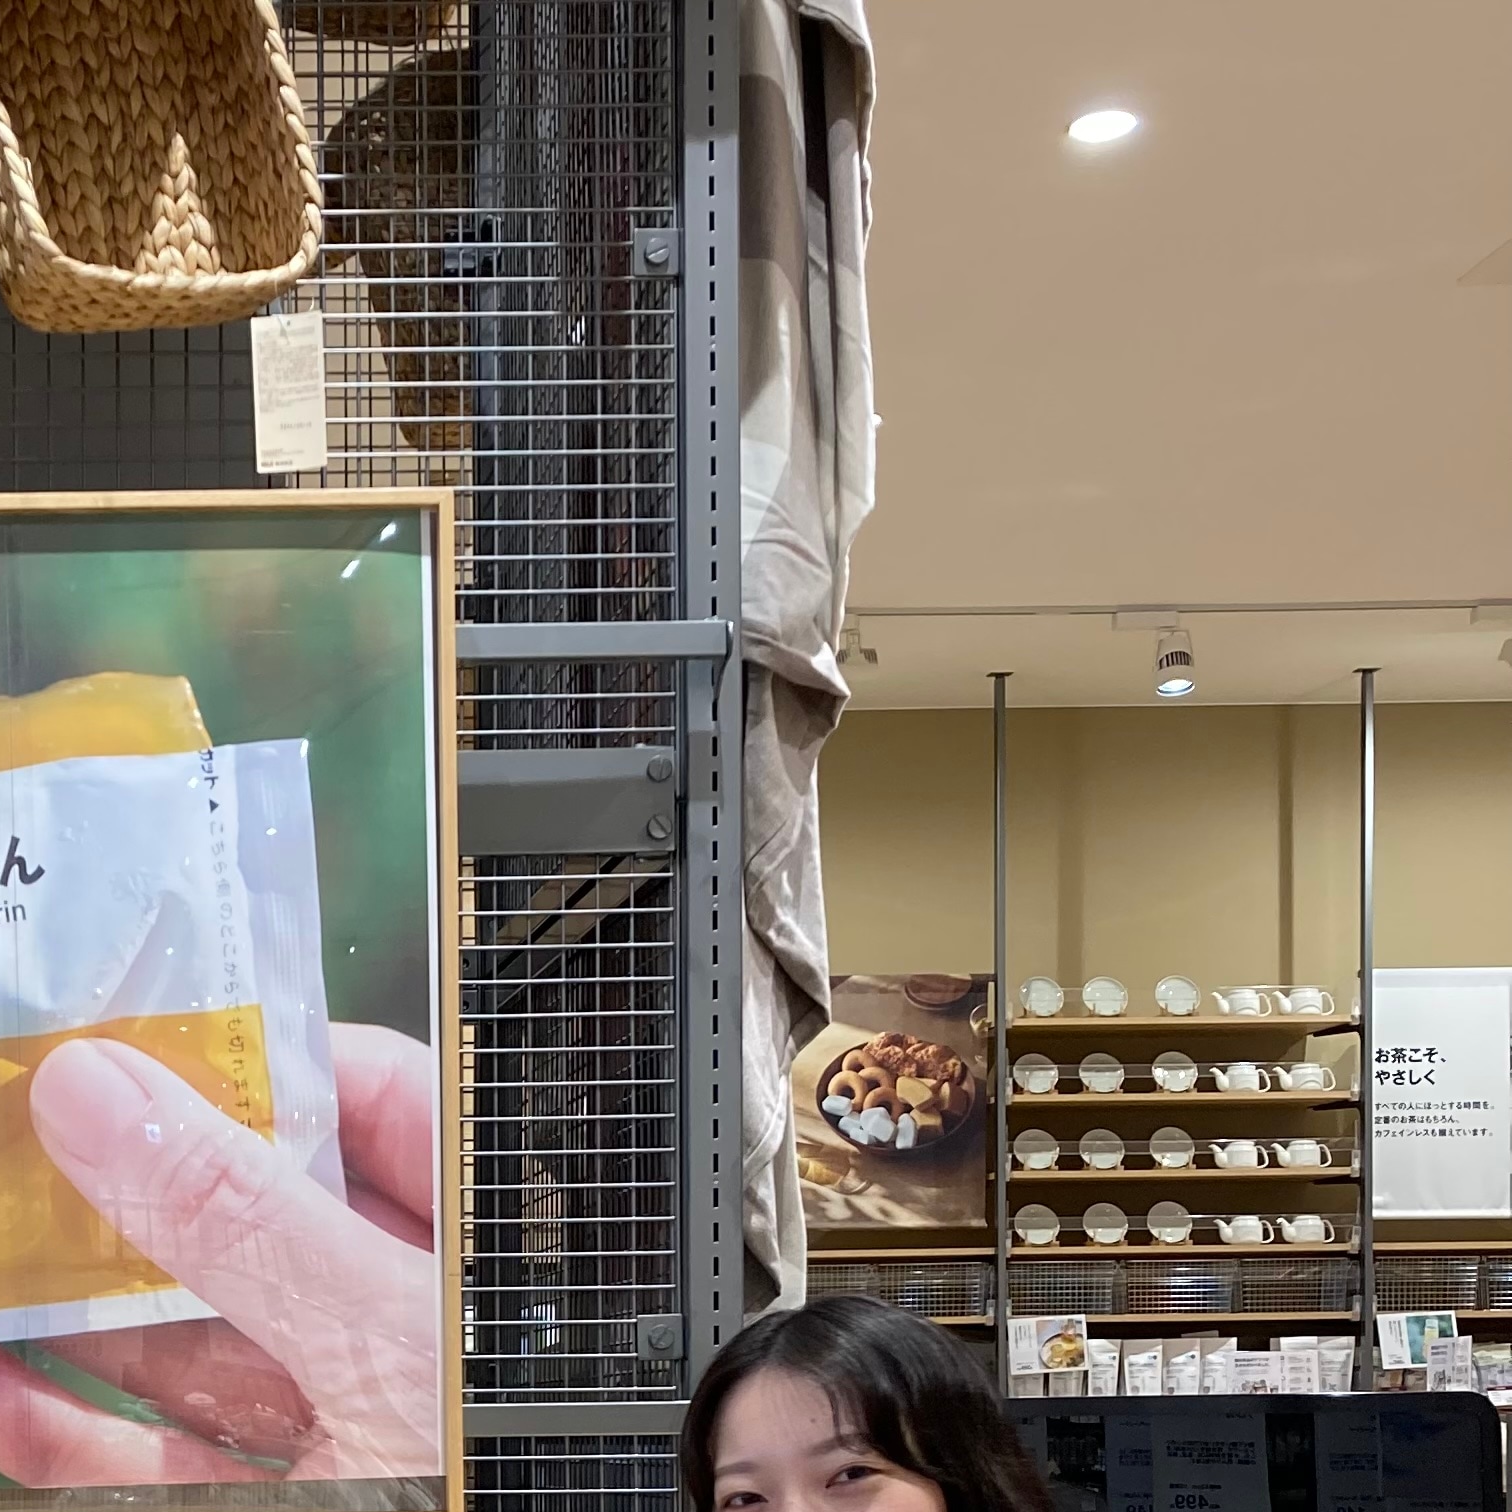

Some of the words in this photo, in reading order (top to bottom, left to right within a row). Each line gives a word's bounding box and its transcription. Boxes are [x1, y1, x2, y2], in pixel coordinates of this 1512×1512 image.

[1375, 1047, 1446, 1064] お茶こそ、
[1375, 1069, 1435, 1086] やさしく
